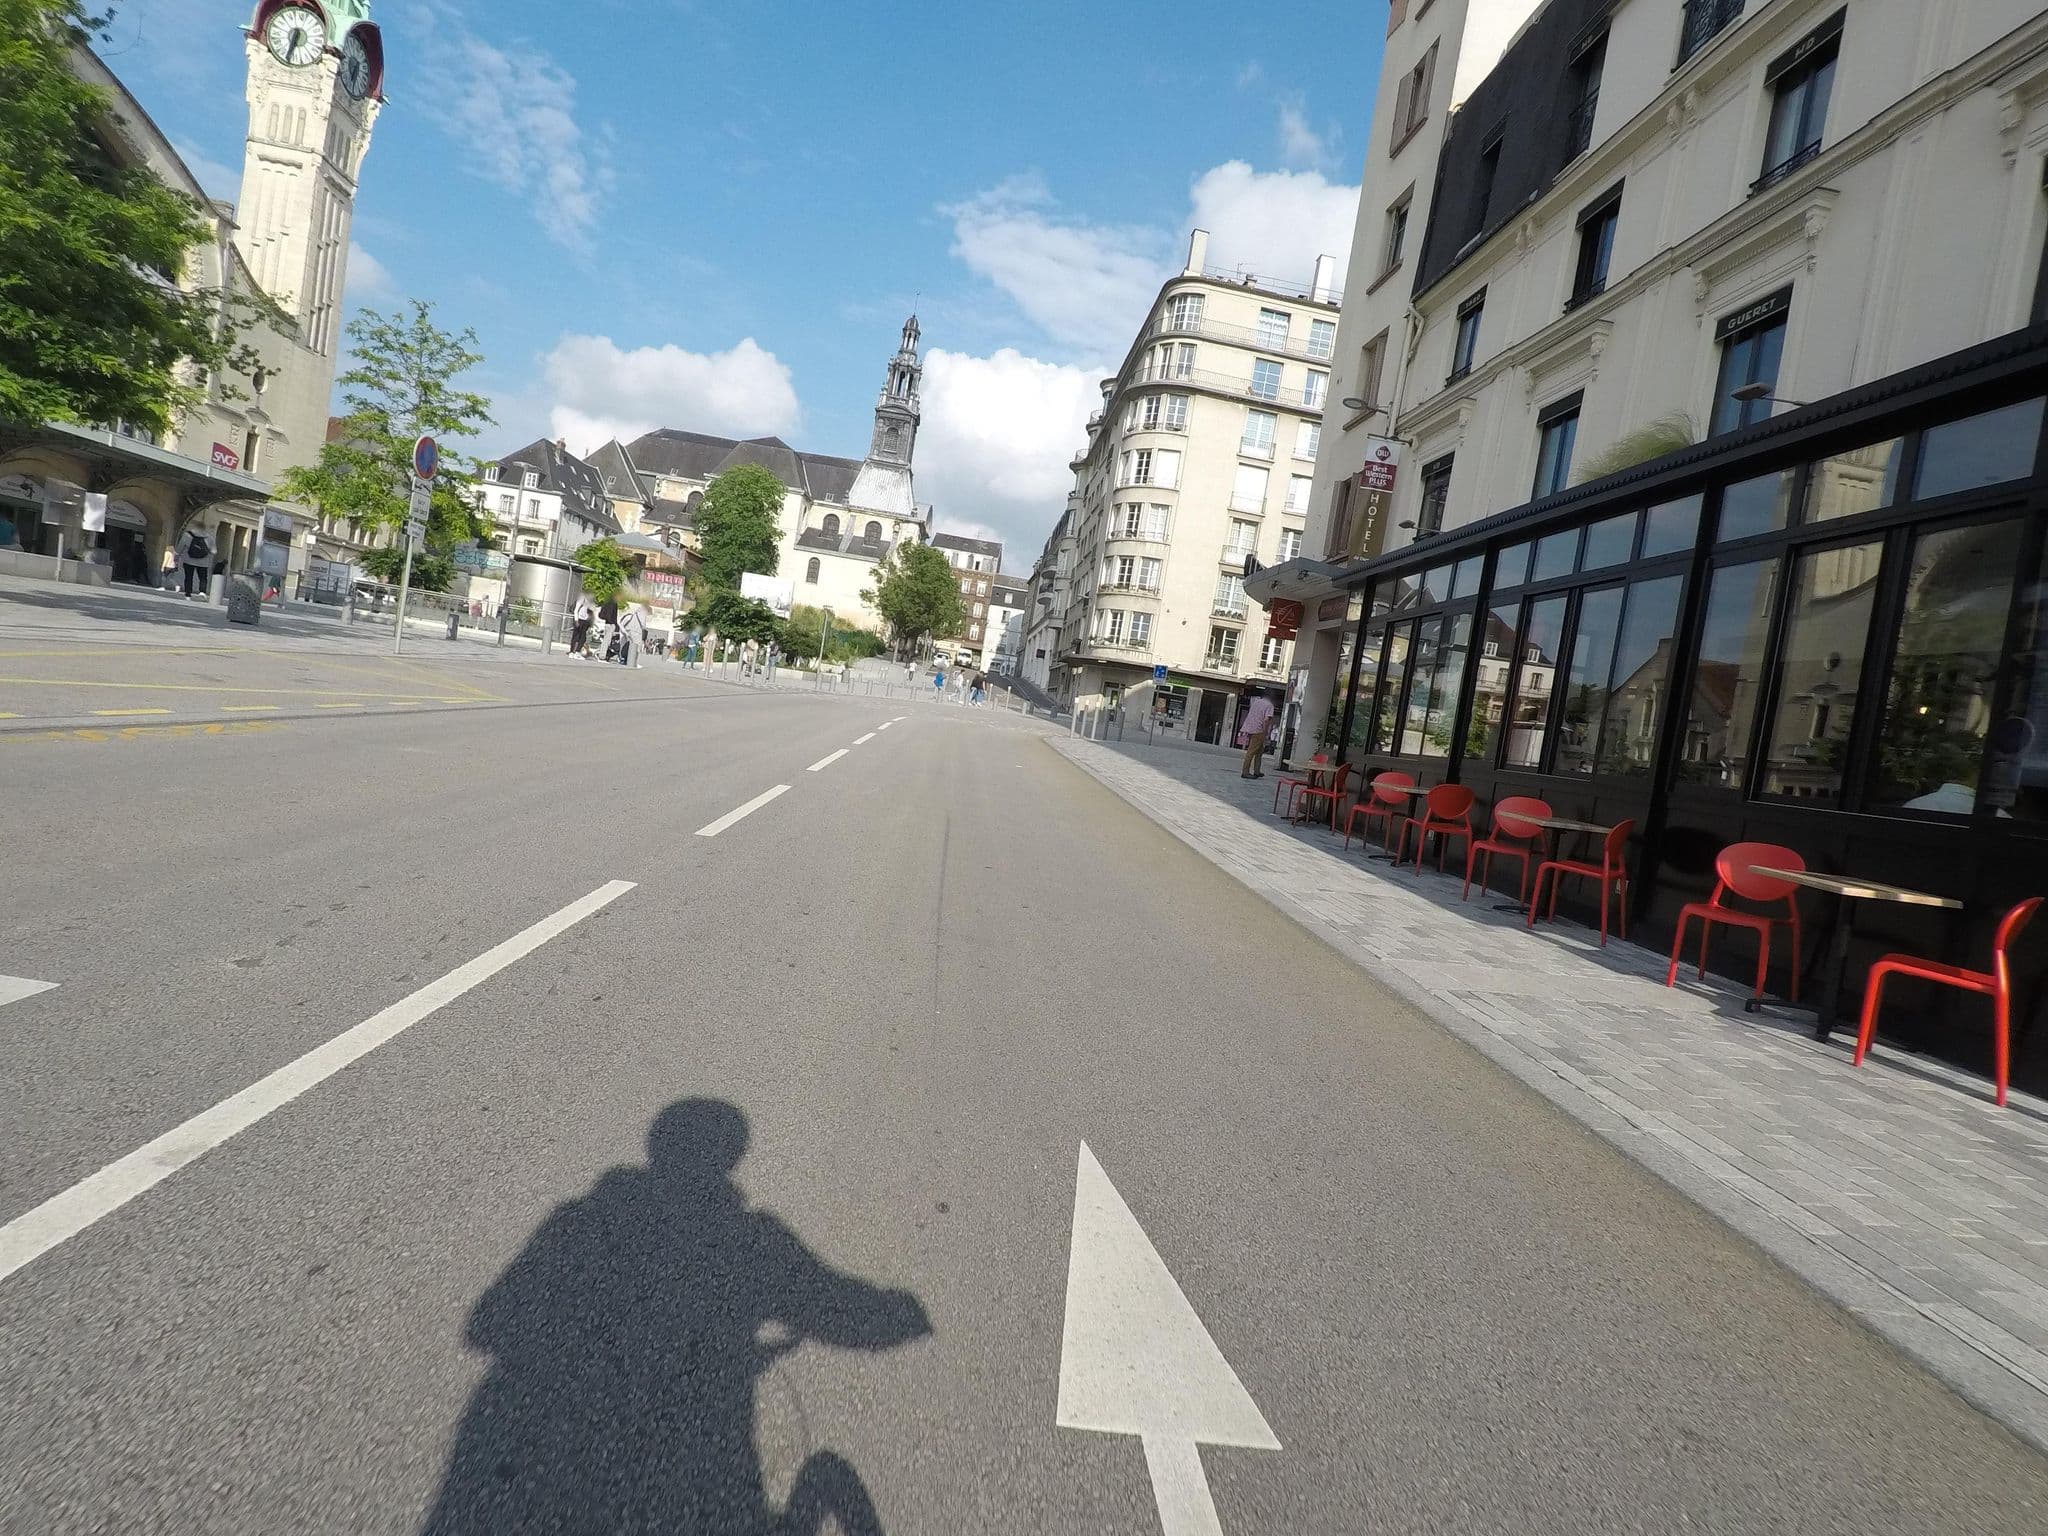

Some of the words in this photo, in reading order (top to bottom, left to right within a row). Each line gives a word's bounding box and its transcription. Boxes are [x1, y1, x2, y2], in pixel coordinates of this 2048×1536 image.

[1727, 298, 1777, 329] GUERET
[212, 451, 239, 466] SNCF
[1365, 470, 1393, 480] Western
[1372, 465, 1388, 474] Best
[1368, 478, 1387, 486] PLUS
[1363, 493, 1380, 553] HOTEL
